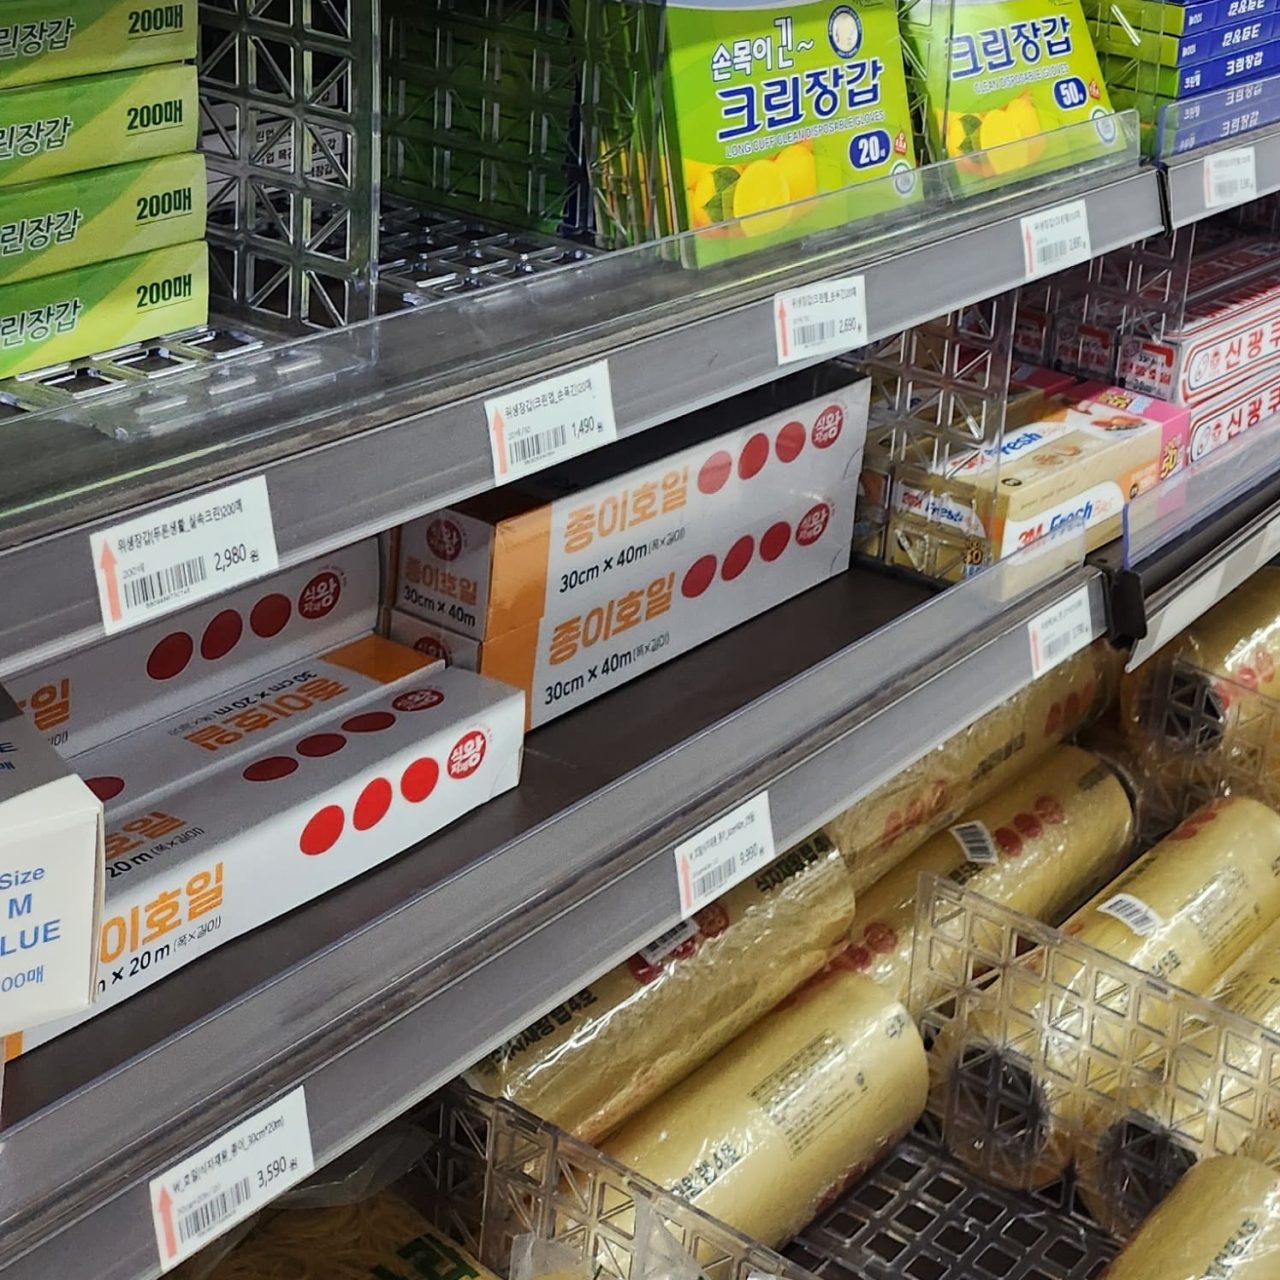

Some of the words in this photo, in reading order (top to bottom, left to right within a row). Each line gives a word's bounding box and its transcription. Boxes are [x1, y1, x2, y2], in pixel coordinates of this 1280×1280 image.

[0, 15, 75, 60] 린장갑
[128, 3, 184, 35] 200매
[945, 15, 1073, 80] 크린장갑
[712, 36, 772, 82] 손목이
[974, 78, 999, 94] CLEAN
[999, 70, 1042, 90] DISPOSABLE
[1041, 63, 1070, 79] GLOVES
[1225, 51, 1264, 77] 크린장갑
[127, 98, 183, 131] 200매
[716, 57, 884, 143] 크린장갑
[725, 143, 752, 159] LONG
[752, 135, 776, 154] CUFF
[776, 129, 807, 146] CLEAN
[806, 117, 854, 141] DISPOSABLE
[854, 109, 886, 127] GLOVES
[1, 207, 83, 257] 린장갑
[136, 186, 193, 222] 200매
[0, 297, 84, 350] 린장갑
[136, 272, 193, 309] 200매
[571, 415, 595, 439] 1,490
[563, 465, 690, 555] 종이호일
[213, 543, 247, 573] 2,980
[1017, 522, 1045, 550] 3M
[404, 553, 478, 606] 종이호일
[559, 564, 600, 594] 30cm
[615, 543, 648, 569] 40m
[403, 583, 436, 612] 30cm
[448, 603, 476, 628] 40m
[548, 570, 676, 667] 종이호일
[544, 675, 585, 706] 30cm
[600, 652, 633, 678] 40m
[0, 865, 46, 891] Size
[105, 846, 155, 880] 20m
[9, 893, 33, 918] M
[100, 861, 225, 965] 이호일
[0, 919, 61, 957] LUE
[129, 942, 171, 973] 20m
[257, 1155, 287, 1190] 3,590
